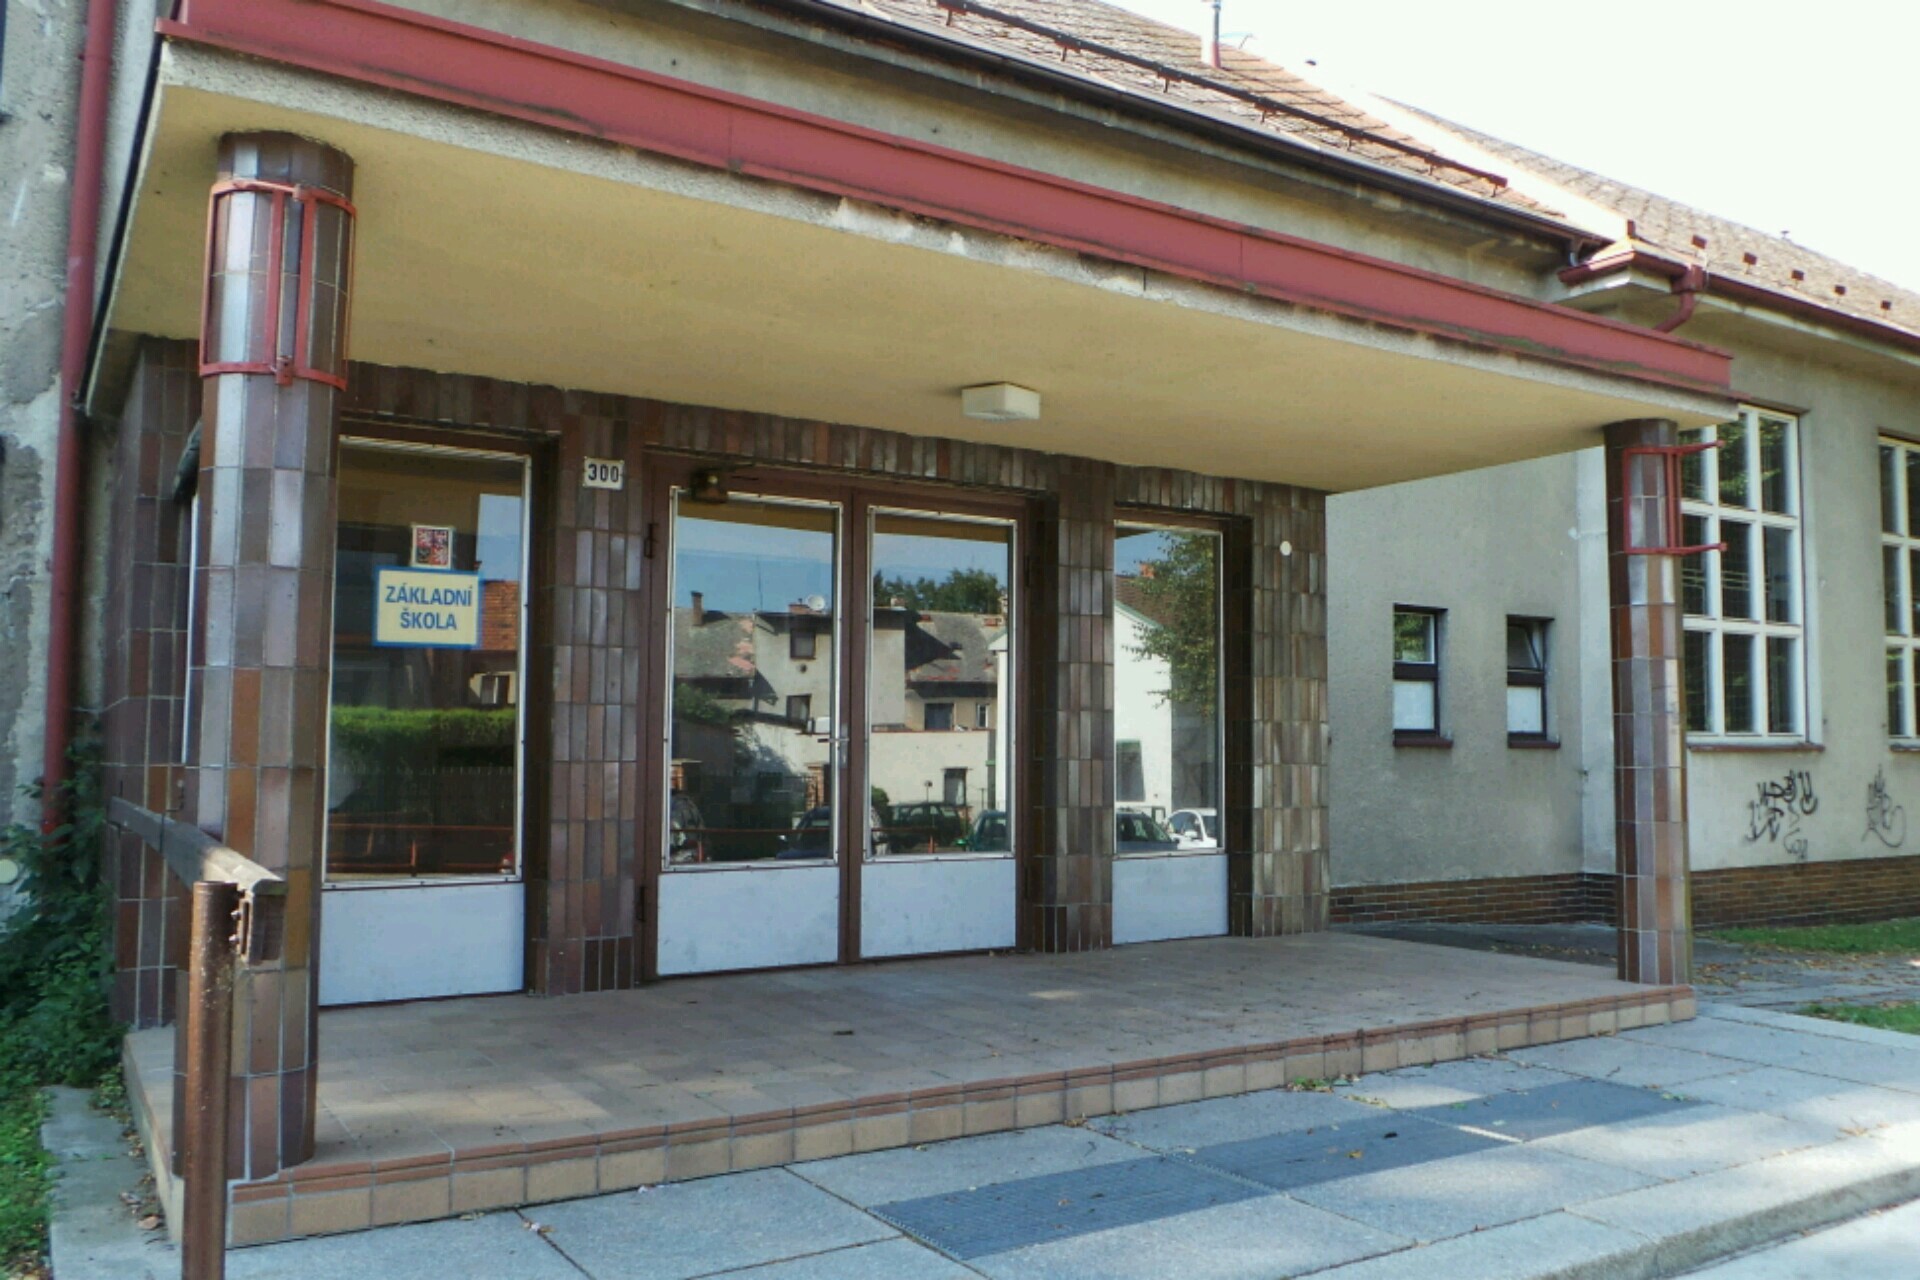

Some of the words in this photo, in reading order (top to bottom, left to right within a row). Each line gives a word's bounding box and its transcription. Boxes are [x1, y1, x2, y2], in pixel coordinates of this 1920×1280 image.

[588, 463, 619, 483] 300
[385, 582, 473, 607] ZÁKLADNÍ
[400, 607, 457, 630] ŠKOLA
